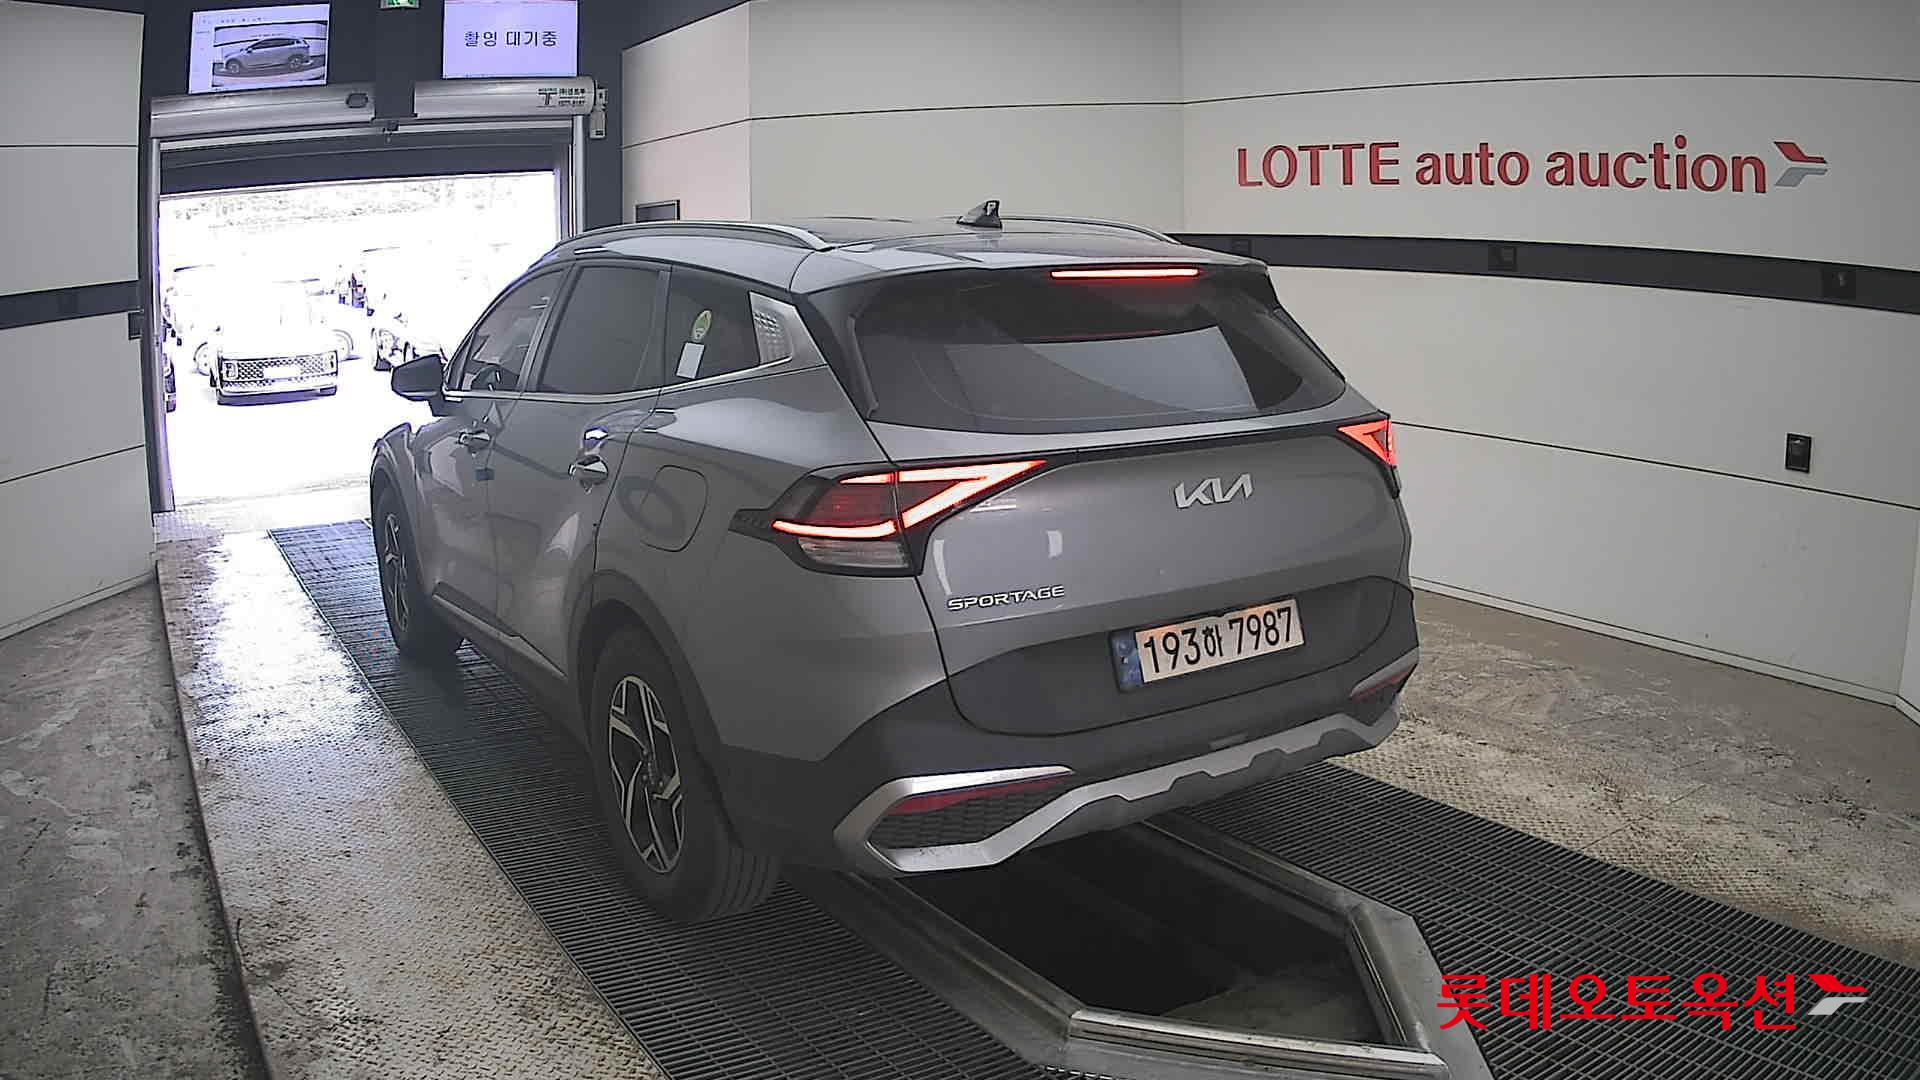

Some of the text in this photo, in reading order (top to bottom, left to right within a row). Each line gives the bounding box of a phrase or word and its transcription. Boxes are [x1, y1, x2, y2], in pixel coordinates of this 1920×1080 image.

[505, 30, 558, 47] 대기중
[1237, 134, 1767, 194] LOTTE auto auction
[1174, 473, 1253, 509] KIA
[947, 585, 1065, 612] SPORTAGE
[1144, 606, 1292, 674] 193하 7987
